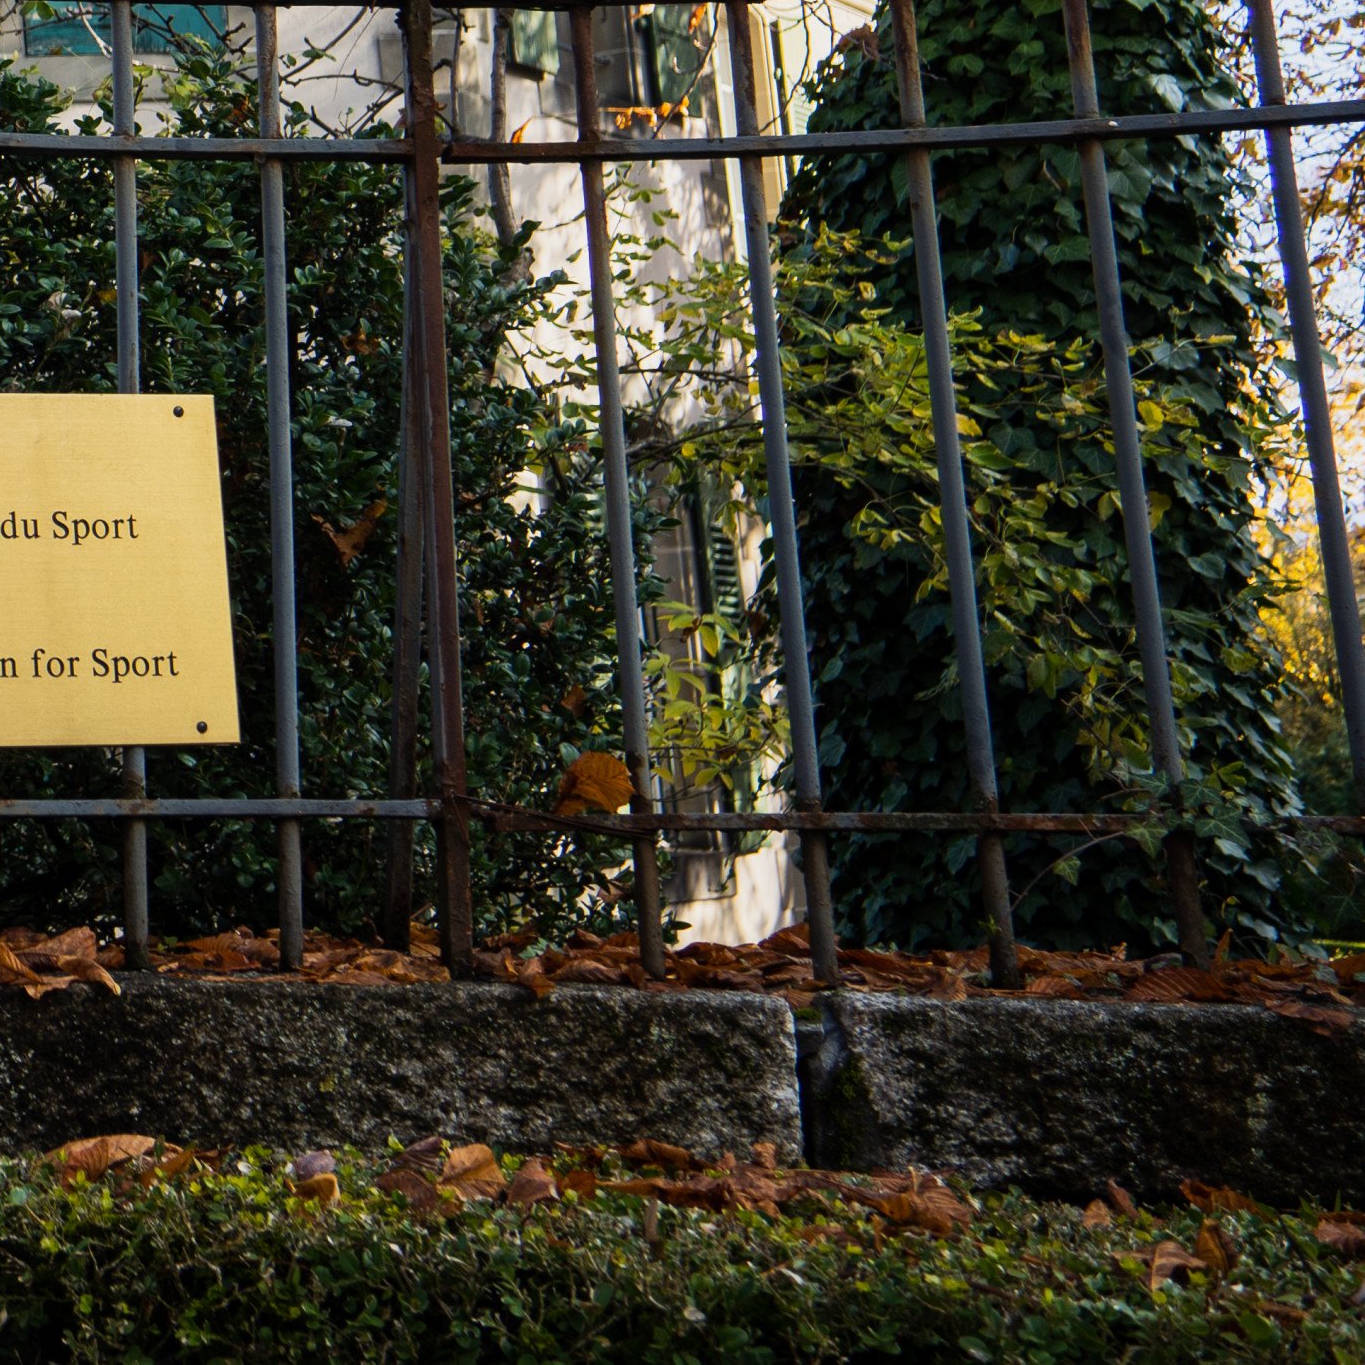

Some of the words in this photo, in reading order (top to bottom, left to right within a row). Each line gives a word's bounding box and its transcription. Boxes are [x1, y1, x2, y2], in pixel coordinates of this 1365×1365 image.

[1, 512, 40, 539] du
[52, 512, 139, 546] Sport
[32, 648, 79, 678] for
[92, 648, 179, 683] Sport
